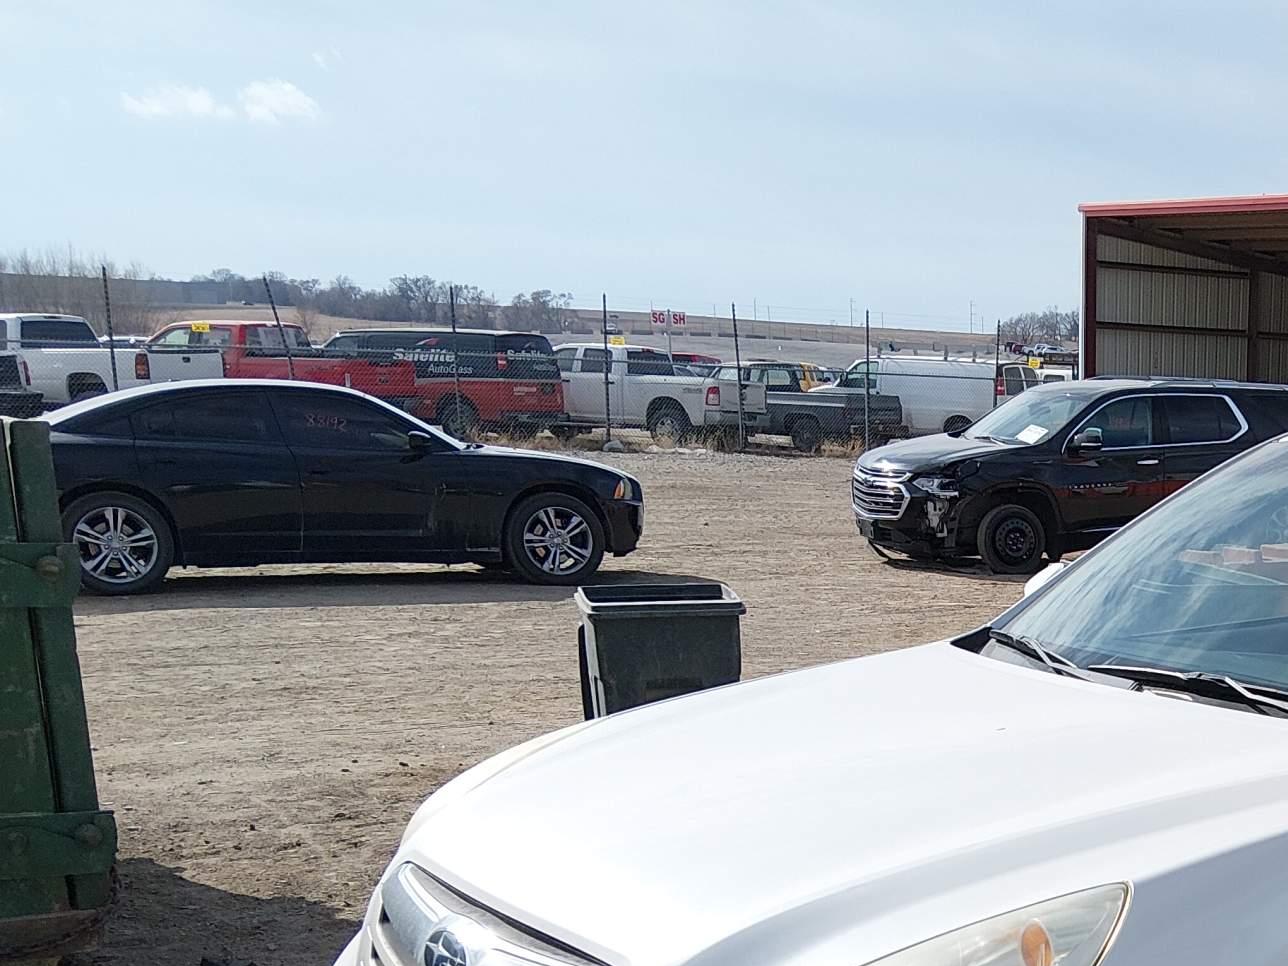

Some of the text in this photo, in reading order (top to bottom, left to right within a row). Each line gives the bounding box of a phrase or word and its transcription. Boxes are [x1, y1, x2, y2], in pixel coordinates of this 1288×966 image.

[652, 312, 665, 324] SG
[672, 313, 686, 325] SH
[393, 348, 455, 362] Safelite
[428, 363, 474, 374] AutoGass
